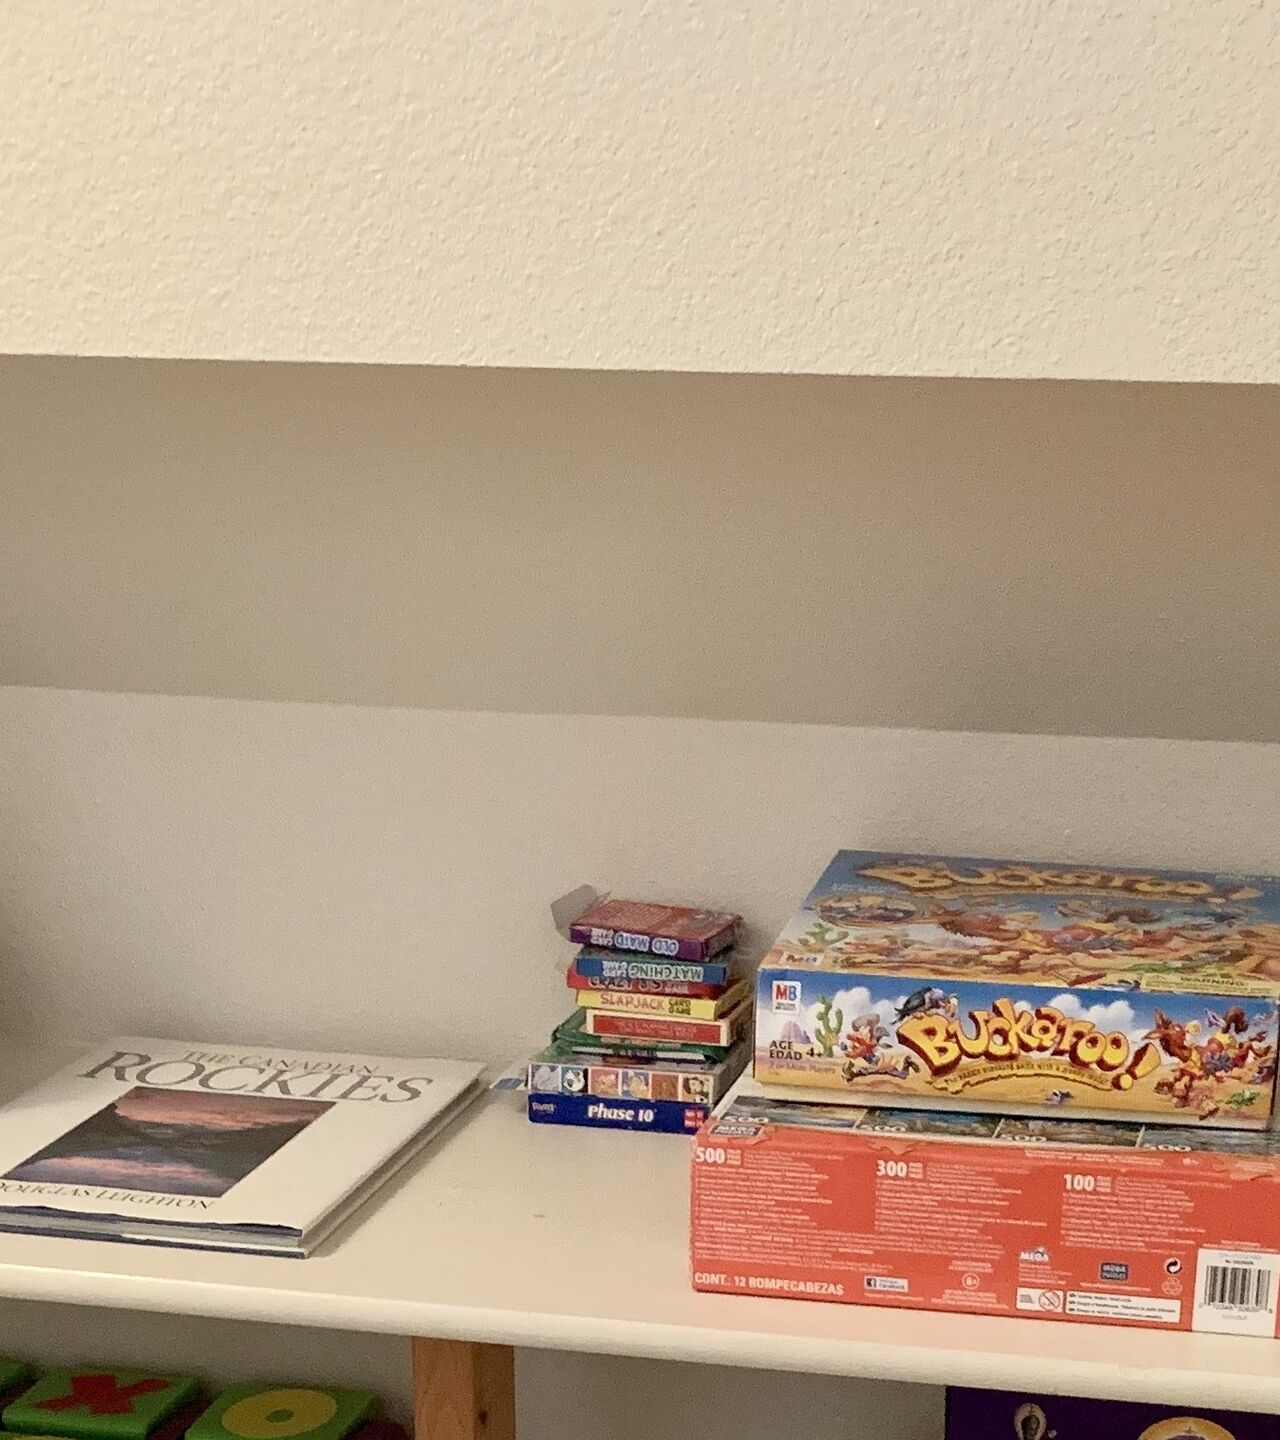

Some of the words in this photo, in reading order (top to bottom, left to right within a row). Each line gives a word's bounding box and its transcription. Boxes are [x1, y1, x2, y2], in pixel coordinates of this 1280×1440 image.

[615, 932, 650, 951] MAID
[652, 940, 679, 955] OLD
[628, 963, 703, 982] MATCHING
[600, 992, 664, 1010] SLAPJACK
[775, 984, 797, 1000] MB
[769, 1040, 793, 1049] AGE
[183, 1051, 235, 1063] THE
[240, 1055, 380, 1074] CANADIAN
[769, 1051, 802, 1060] EDAD
[78, 1051, 433, 1103] ROCKIES
[588, 1103, 635, 1121] Phase
[638, 1109, 654, 1122] 10
[695, 1147, 726, 1164] 500
[876, 1160, 907, 1177] 300
[1064, 1174, 1095, 1191] 100
[95, 1188, 215, 1210] LEIGHTON
[734, 1276, 746, 1288] 12
[749, 1277, 844, 1296] ROMPECABEZAS
